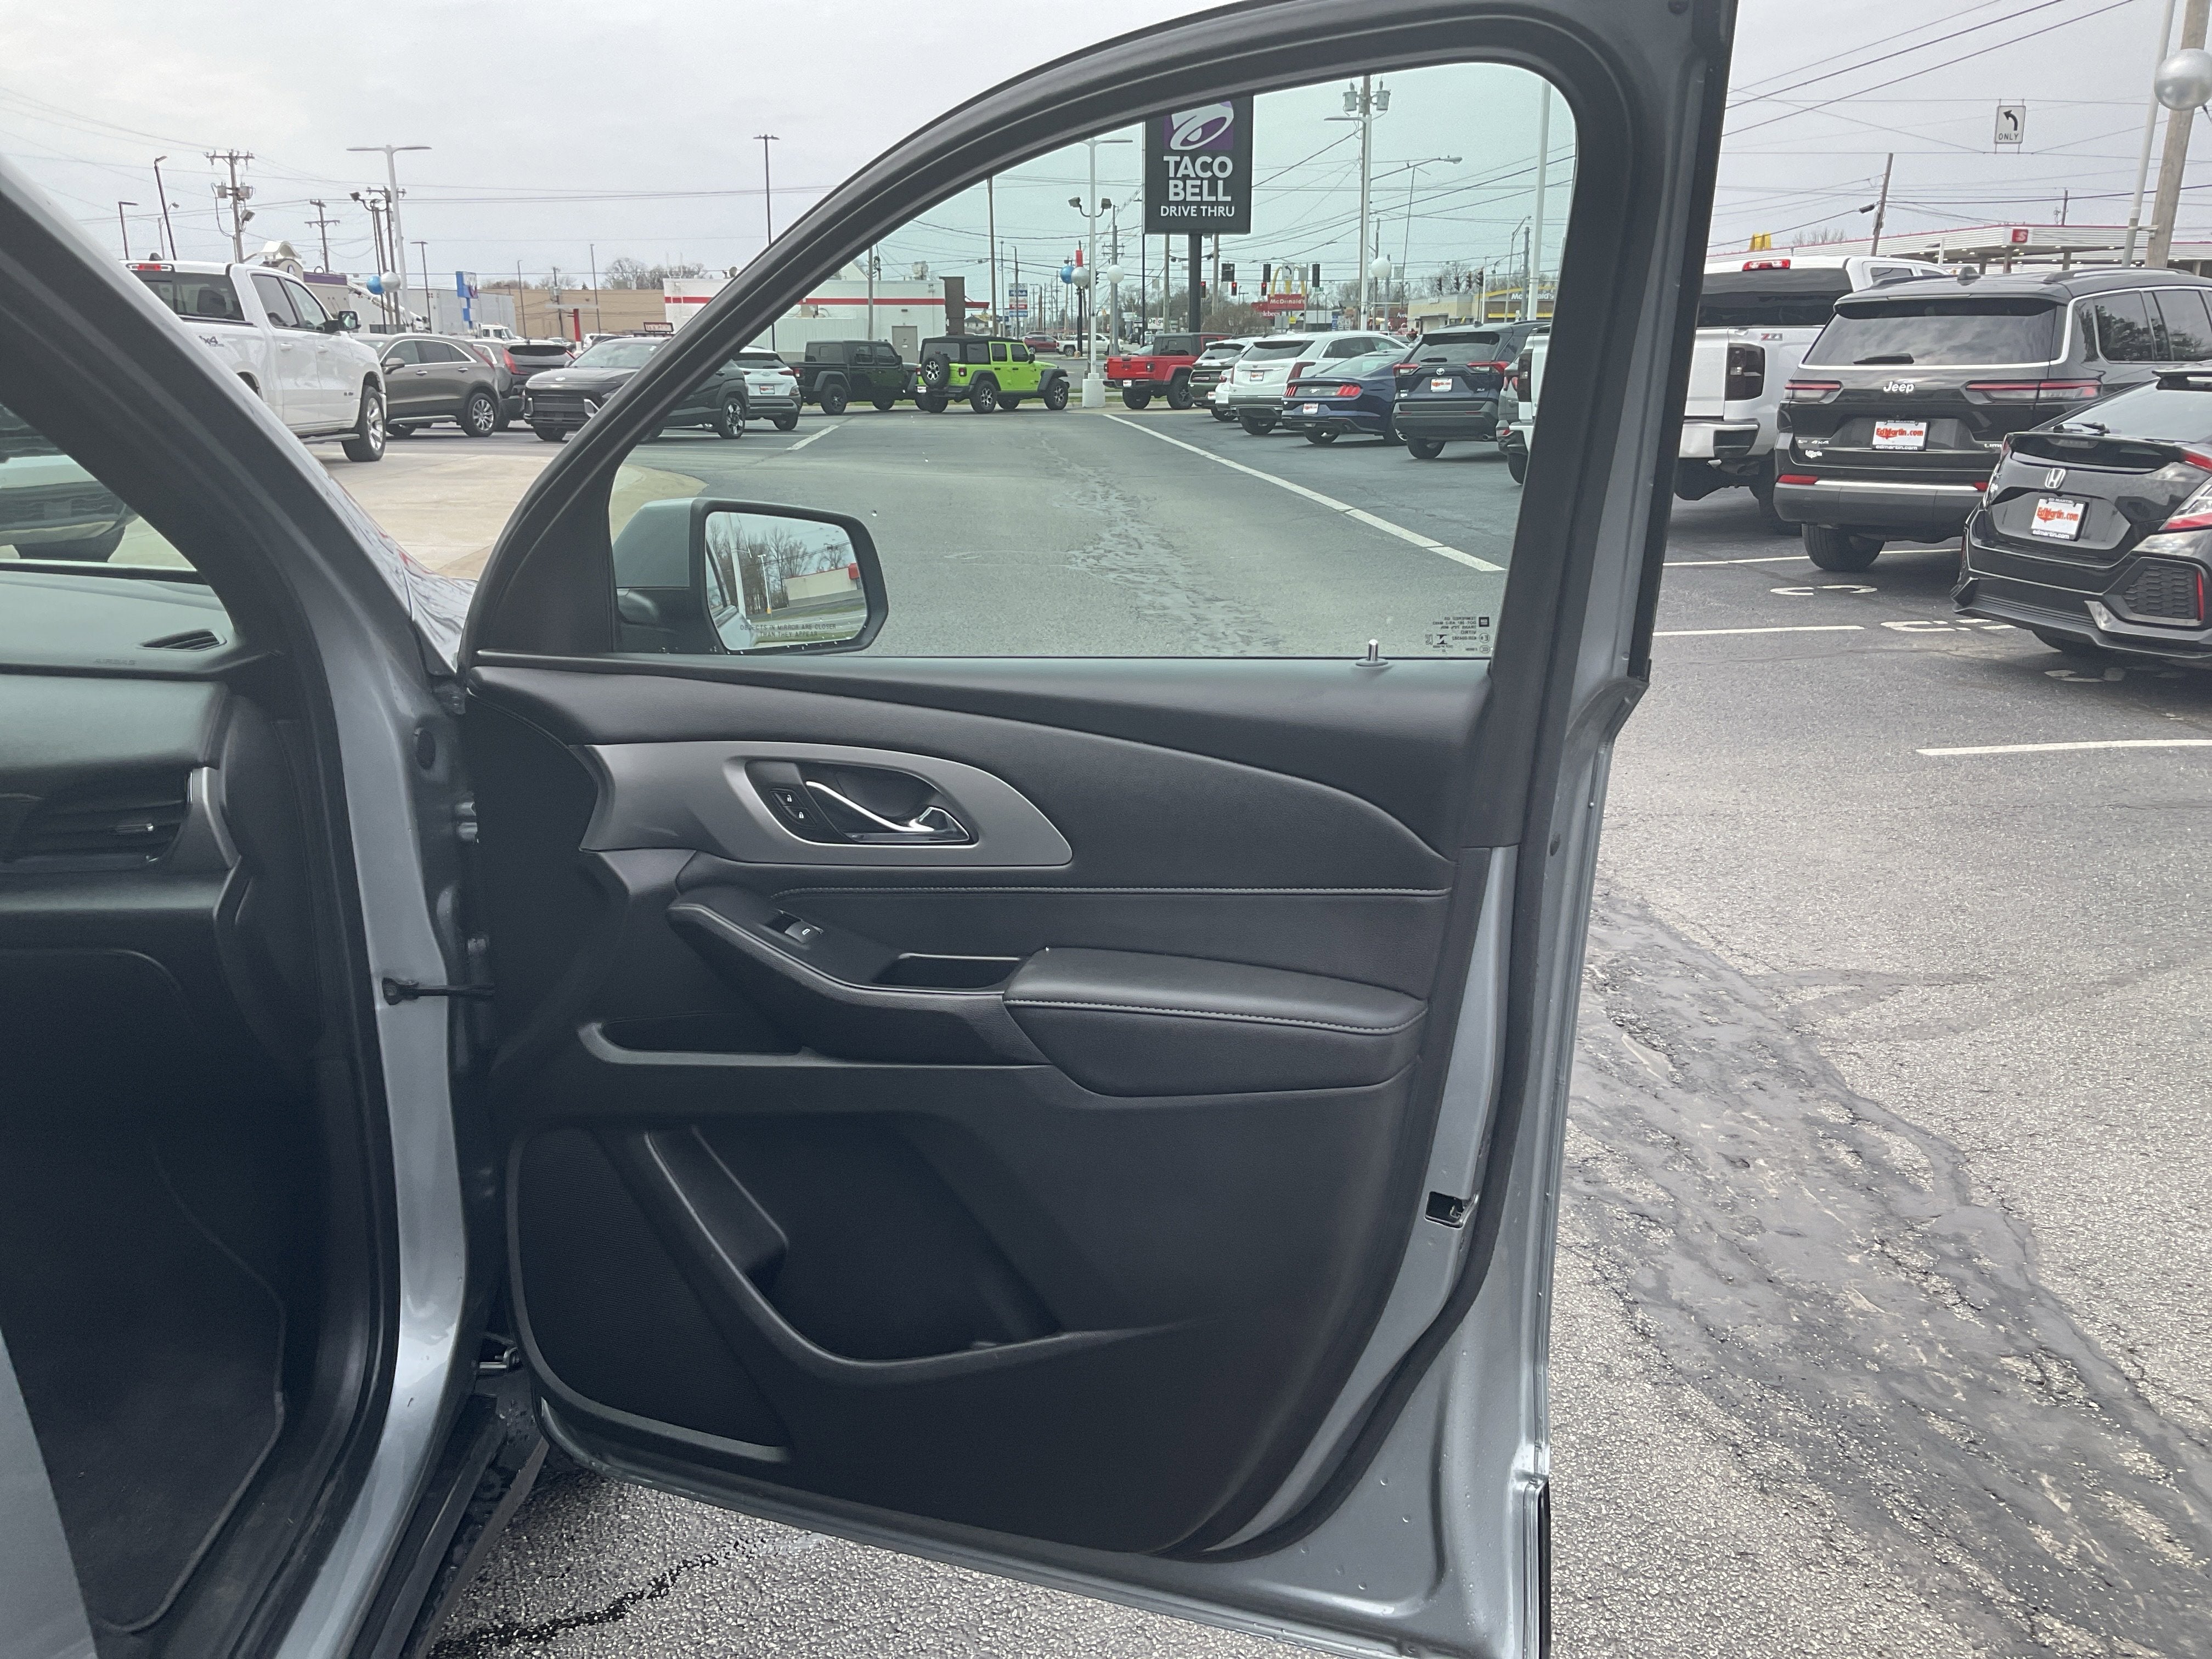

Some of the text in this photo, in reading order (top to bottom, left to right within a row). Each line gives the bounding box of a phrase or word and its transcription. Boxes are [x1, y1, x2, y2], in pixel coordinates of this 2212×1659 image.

[1163, 156, 1233, 178] TACO
[1169, 179, 1232, 201] BELL
[1160, 206, 1235, 217] DRIVE THRU
[1883, 381, 1915, 393] Jeep
[2032, 530, 2070, 539] edmartin.com
